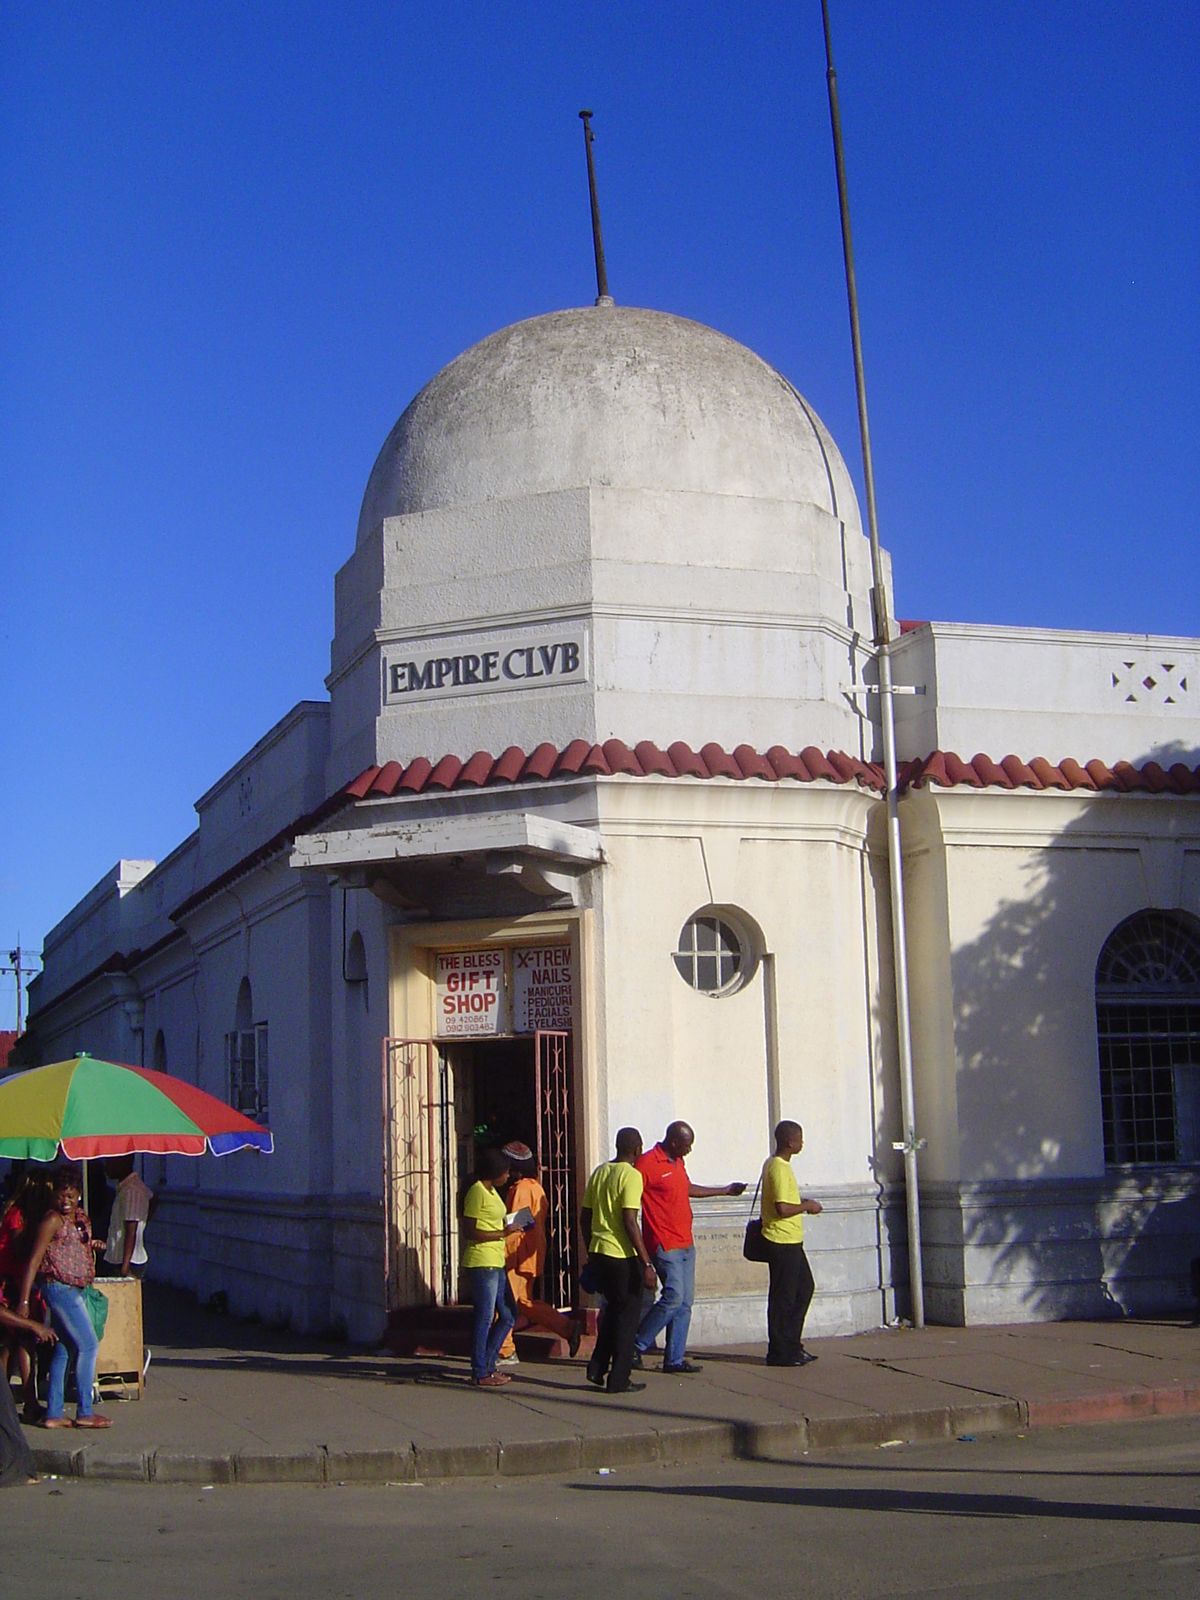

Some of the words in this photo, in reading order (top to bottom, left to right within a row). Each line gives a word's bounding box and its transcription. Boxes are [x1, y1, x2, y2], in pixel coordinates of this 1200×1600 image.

[389, 651, 500, 694] EMPIRE
[439, 957, 459, 970] THE
[463, 953, 500, 968] BLESS
[446, 970, 494, 992] GIFT
[532, 968, 571, 984] NAILS
[443, 993, 496, 1014] SHOP
[528, 1006, 570, 1018] FACIALS
